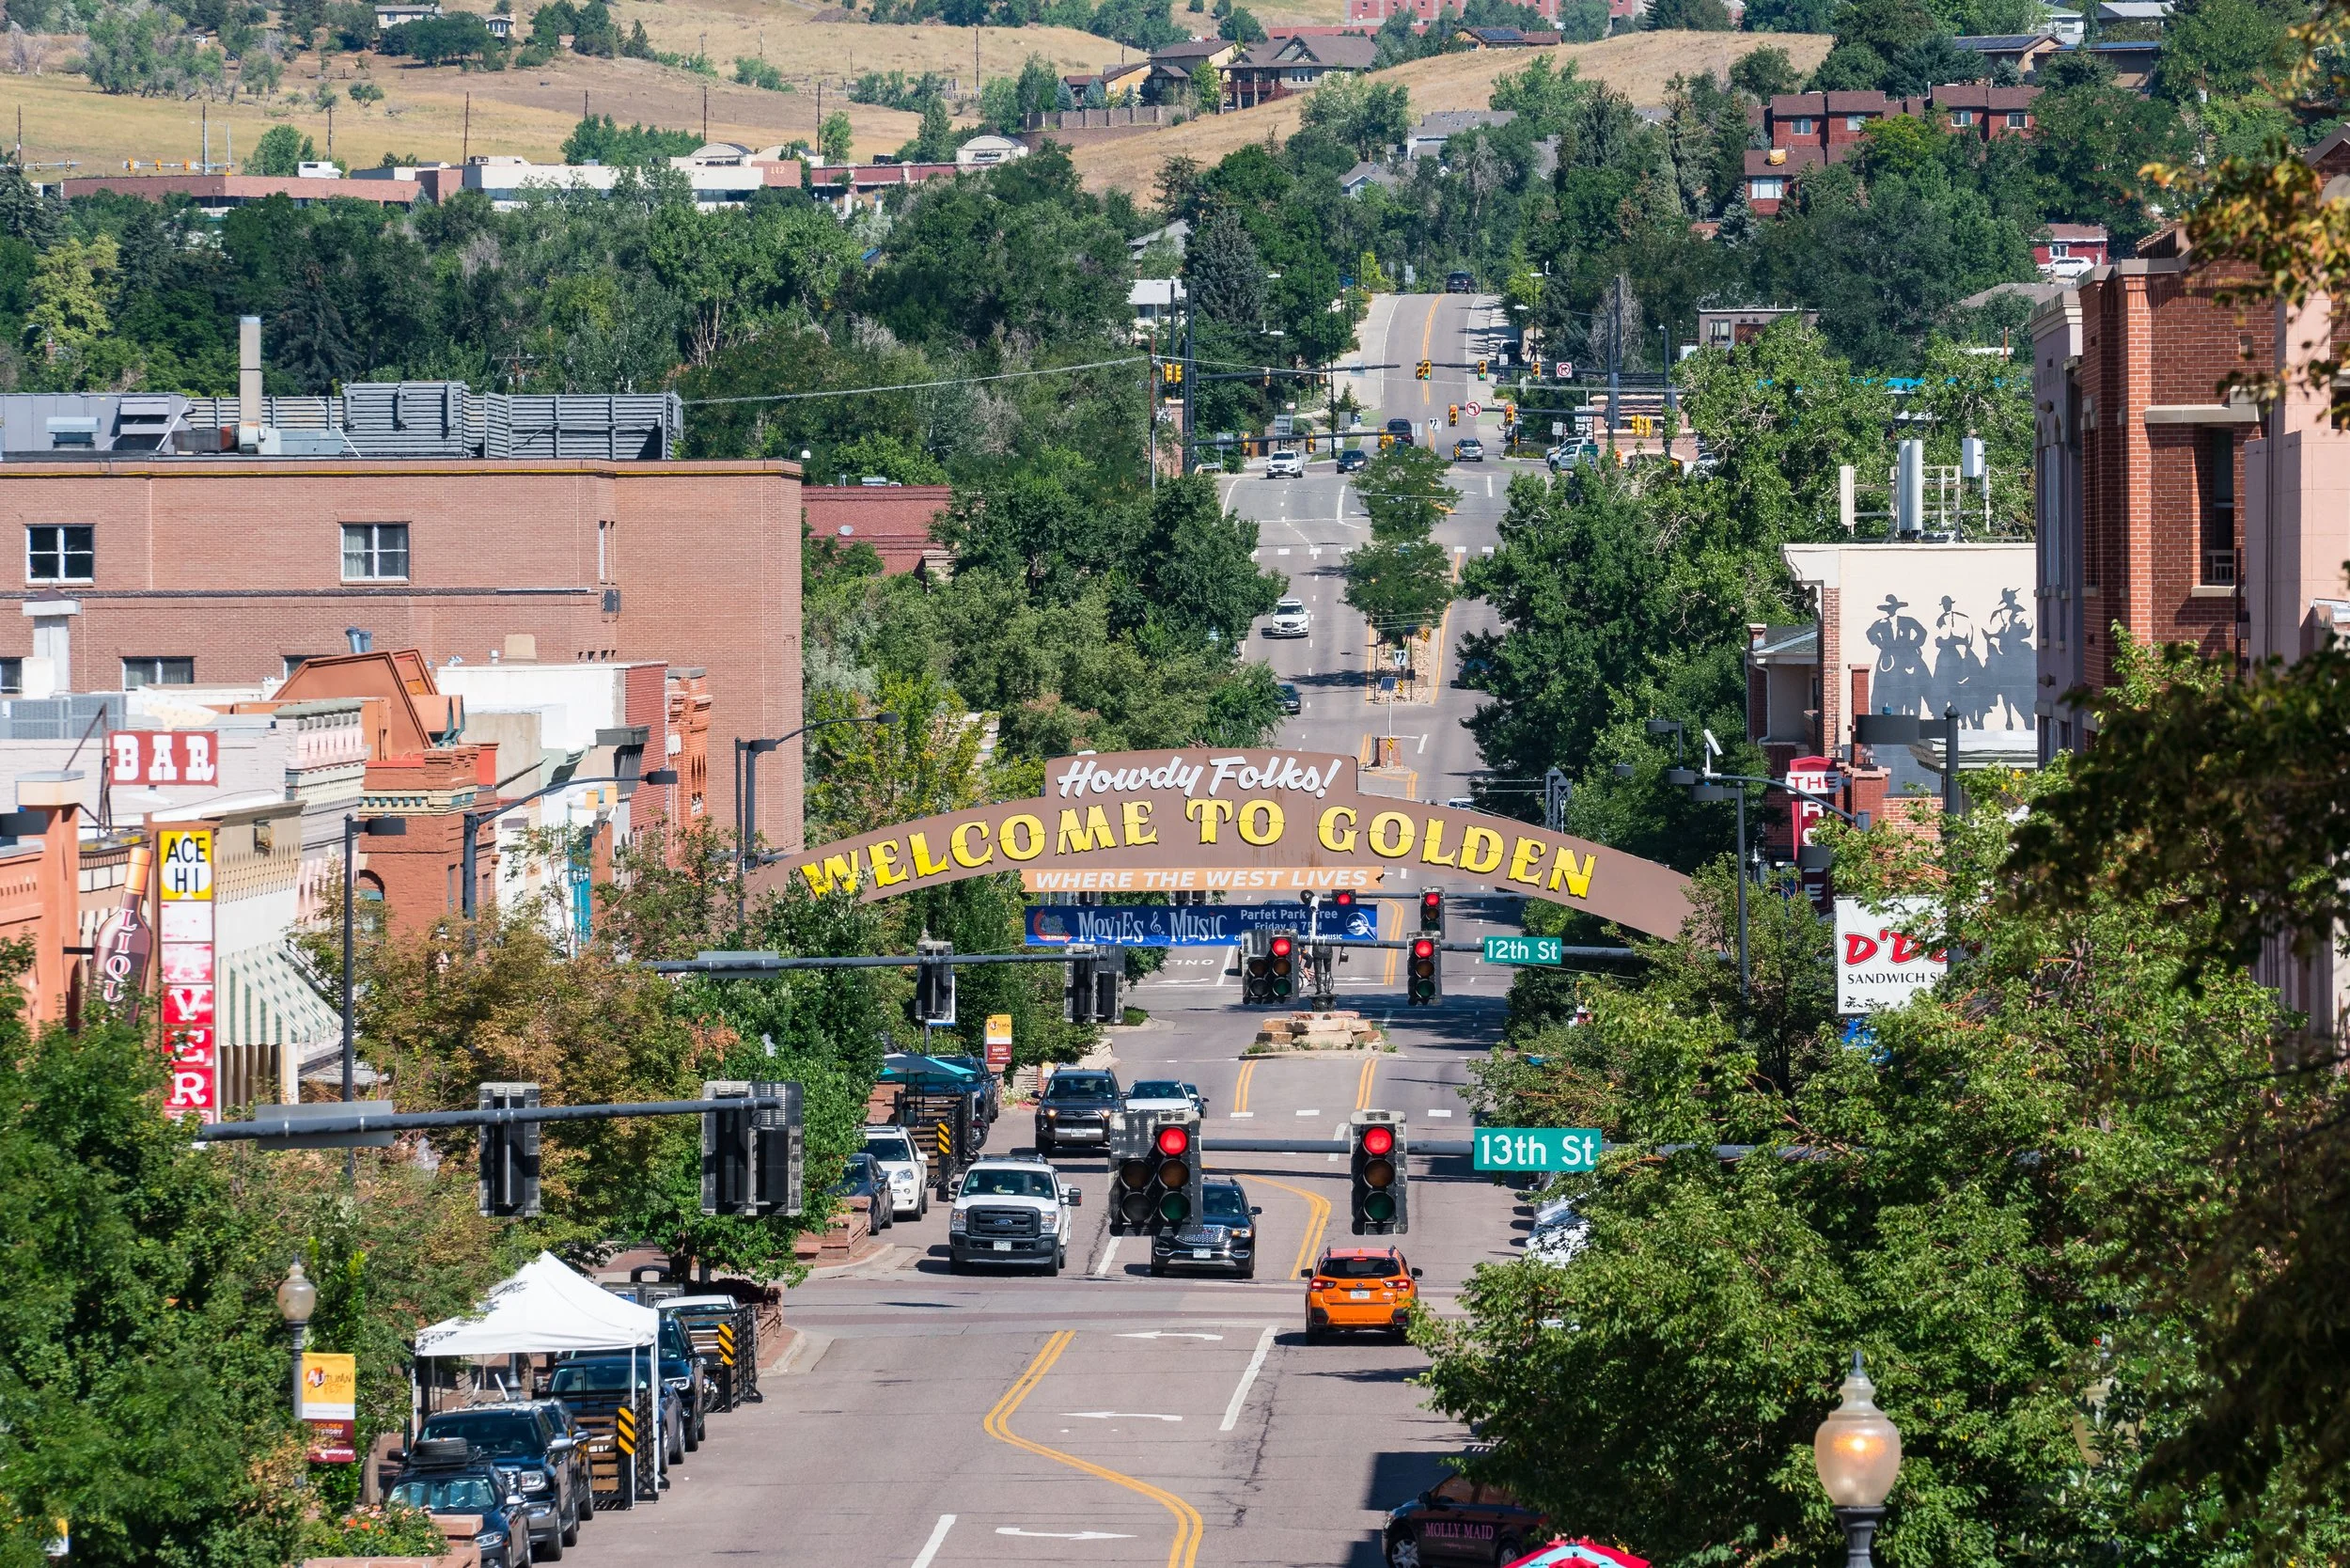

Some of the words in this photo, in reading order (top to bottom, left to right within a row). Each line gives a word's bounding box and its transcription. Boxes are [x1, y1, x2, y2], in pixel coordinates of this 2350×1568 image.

[113, 734, 214, 782] BAR
[1057, 755, 1202, 799] Howdy
[1208, 756, 1342, 799] Folks!
[1790, 776, 1837, 790] THE
[165, 838, 206, 864] ACE
[800, 799, 1158, 901] WELCOME
[1185, 798, 1285, 846] TO
[1318, 806, 1597, 899] GOLDEN
[175, 870, 199, 894] HI
[1036, 871, 1135, 888] WHERE
[1144, 870, 1195, 887] THE
[1206, 870, 1285, 887] WEST
[1291, 870, 1368, 886] LIVES
[1241, 909, 1277, 920] Parfet
[1280, 909, 1306, 919] Park
[1255, 921, 1286, 931] Friday
[103, 909, 138, 1006] LIQU
[1487, 940, 1529, 960] 12th
[1538, 941, 1558, 960] St
[1847, 972, 1925, 984] SANDWICH
[167, 944, 208, 1119] AVER
[1480, 1135, 1547, 1166] 13th
[1562, 1134, 1595, 1166] St
[1425, 1522, 1461, 1538] MOLLY
[1464, 1524, 1494, 1541] MAID
